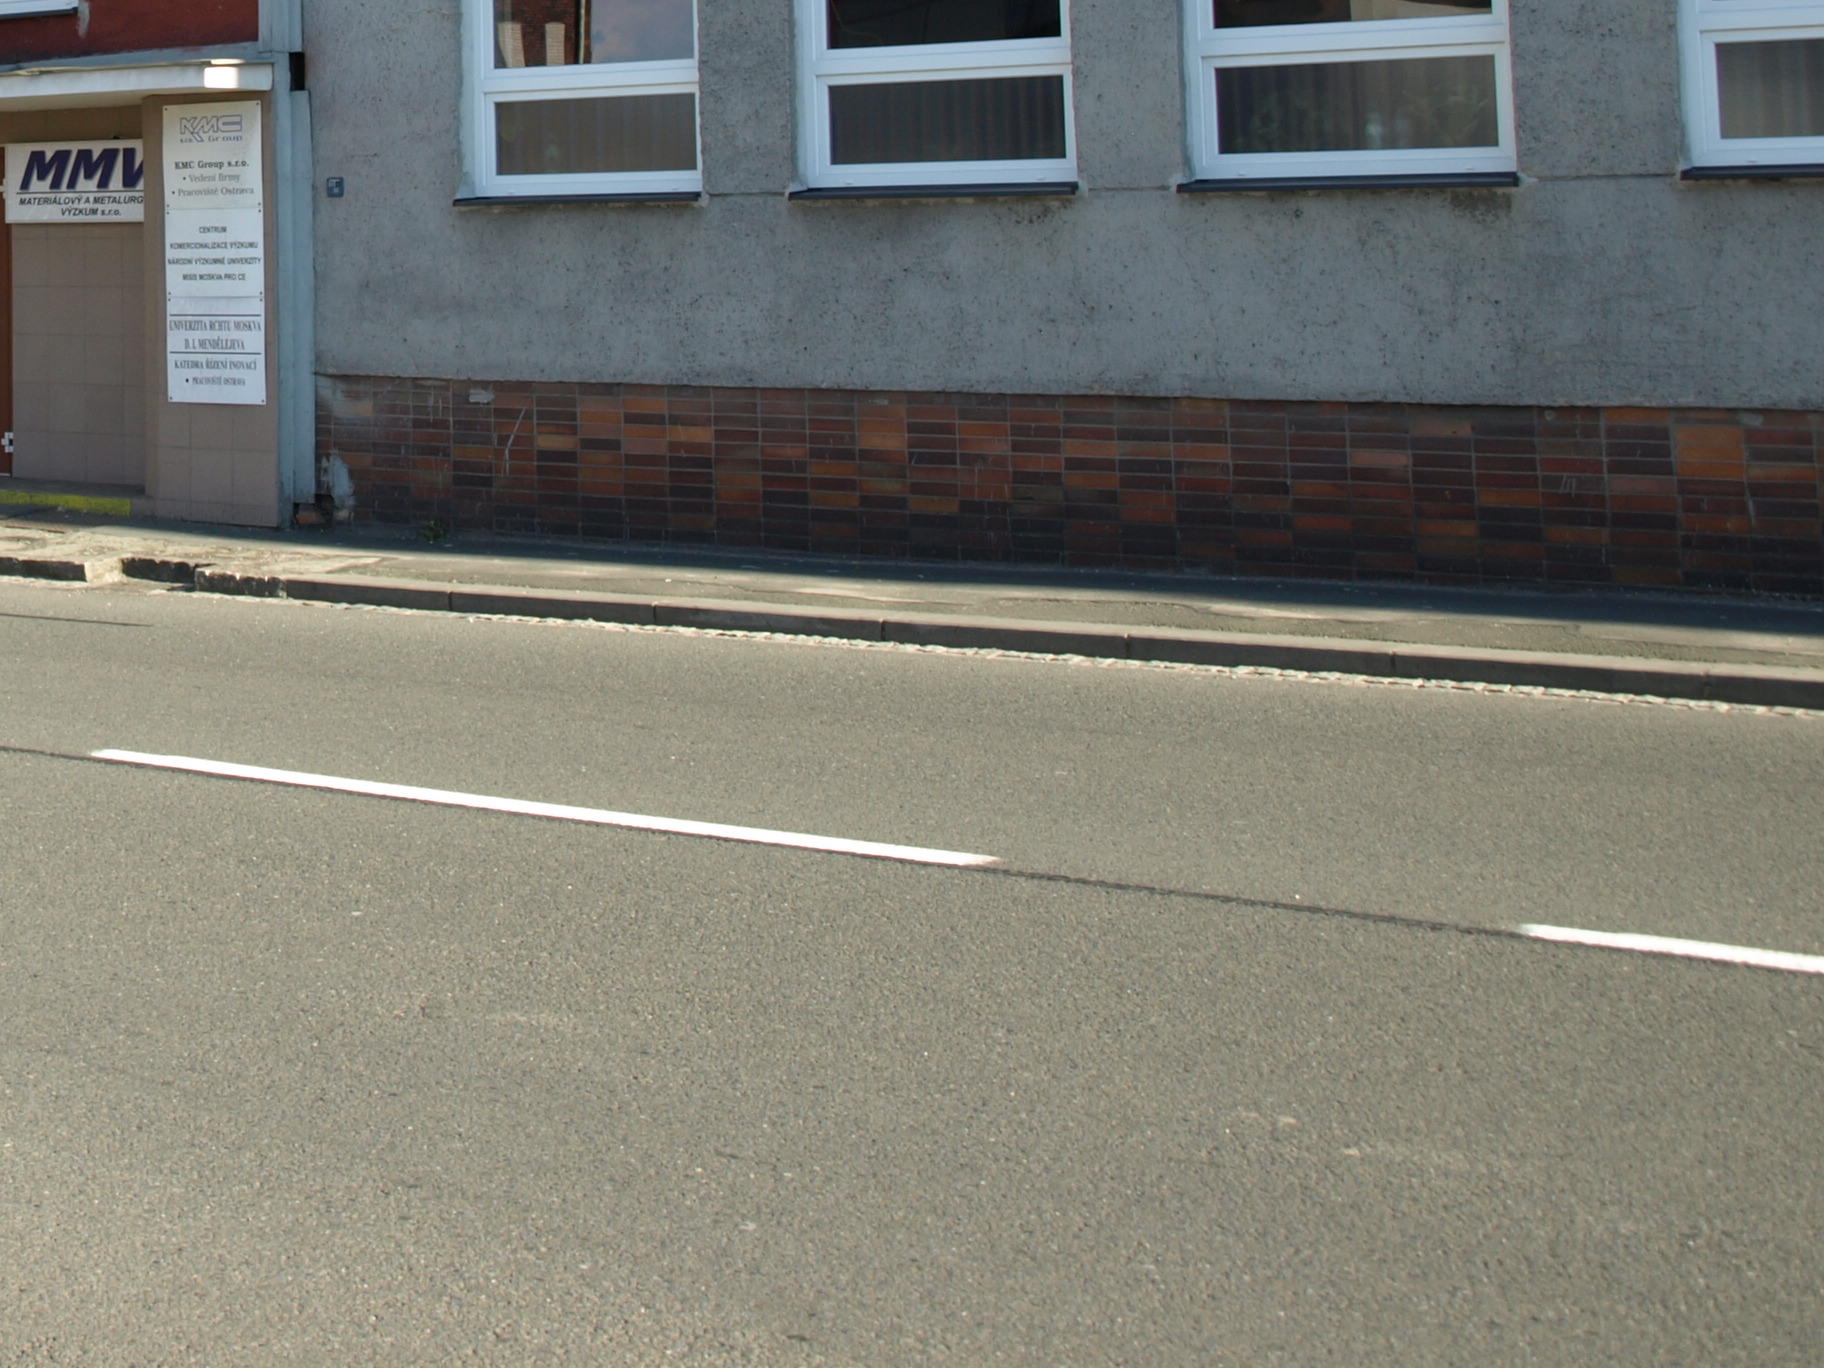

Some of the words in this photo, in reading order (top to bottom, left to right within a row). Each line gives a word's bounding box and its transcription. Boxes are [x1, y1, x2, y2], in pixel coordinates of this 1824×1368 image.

[180, 114, 243, 142] KMC
[175, 161, 194, 170] KMC
[197, 160, 225, 170] Group
[227, 160, 250, 168] s.r.o.
[188, 173, 217, 183] Vedení
[218, 172, 240, 183] firmy
[220, 186, 255, 196] Ostrava
[19, 193, 82, 206] MATERIÁLOVÝ
[84, 195, 91, 204] A
[60, 206, 99, 217] VÝZKUM
[100, 208, 121, 217] s.r.o.
[199, 226, 227, 234] CENTRUM
[167, 256, 194, 265] NÁRODNÍ
[227, 257, 262, 265] UNIVERZITY
[223, 272, 237, 281] PRO
[237, 273, 247, 281] CE
[169, 319, 208, 332] UNIVERZITA
[233, 320, 262, 332] MOSKVA
[174, 359, 204, 370] KATEDRA
[205, 357, 228, 370] ŘÍZENÍ
[229, 358, 258, 371] INOVACÍ
[223, 376, 246, 386] OSTRAVA
